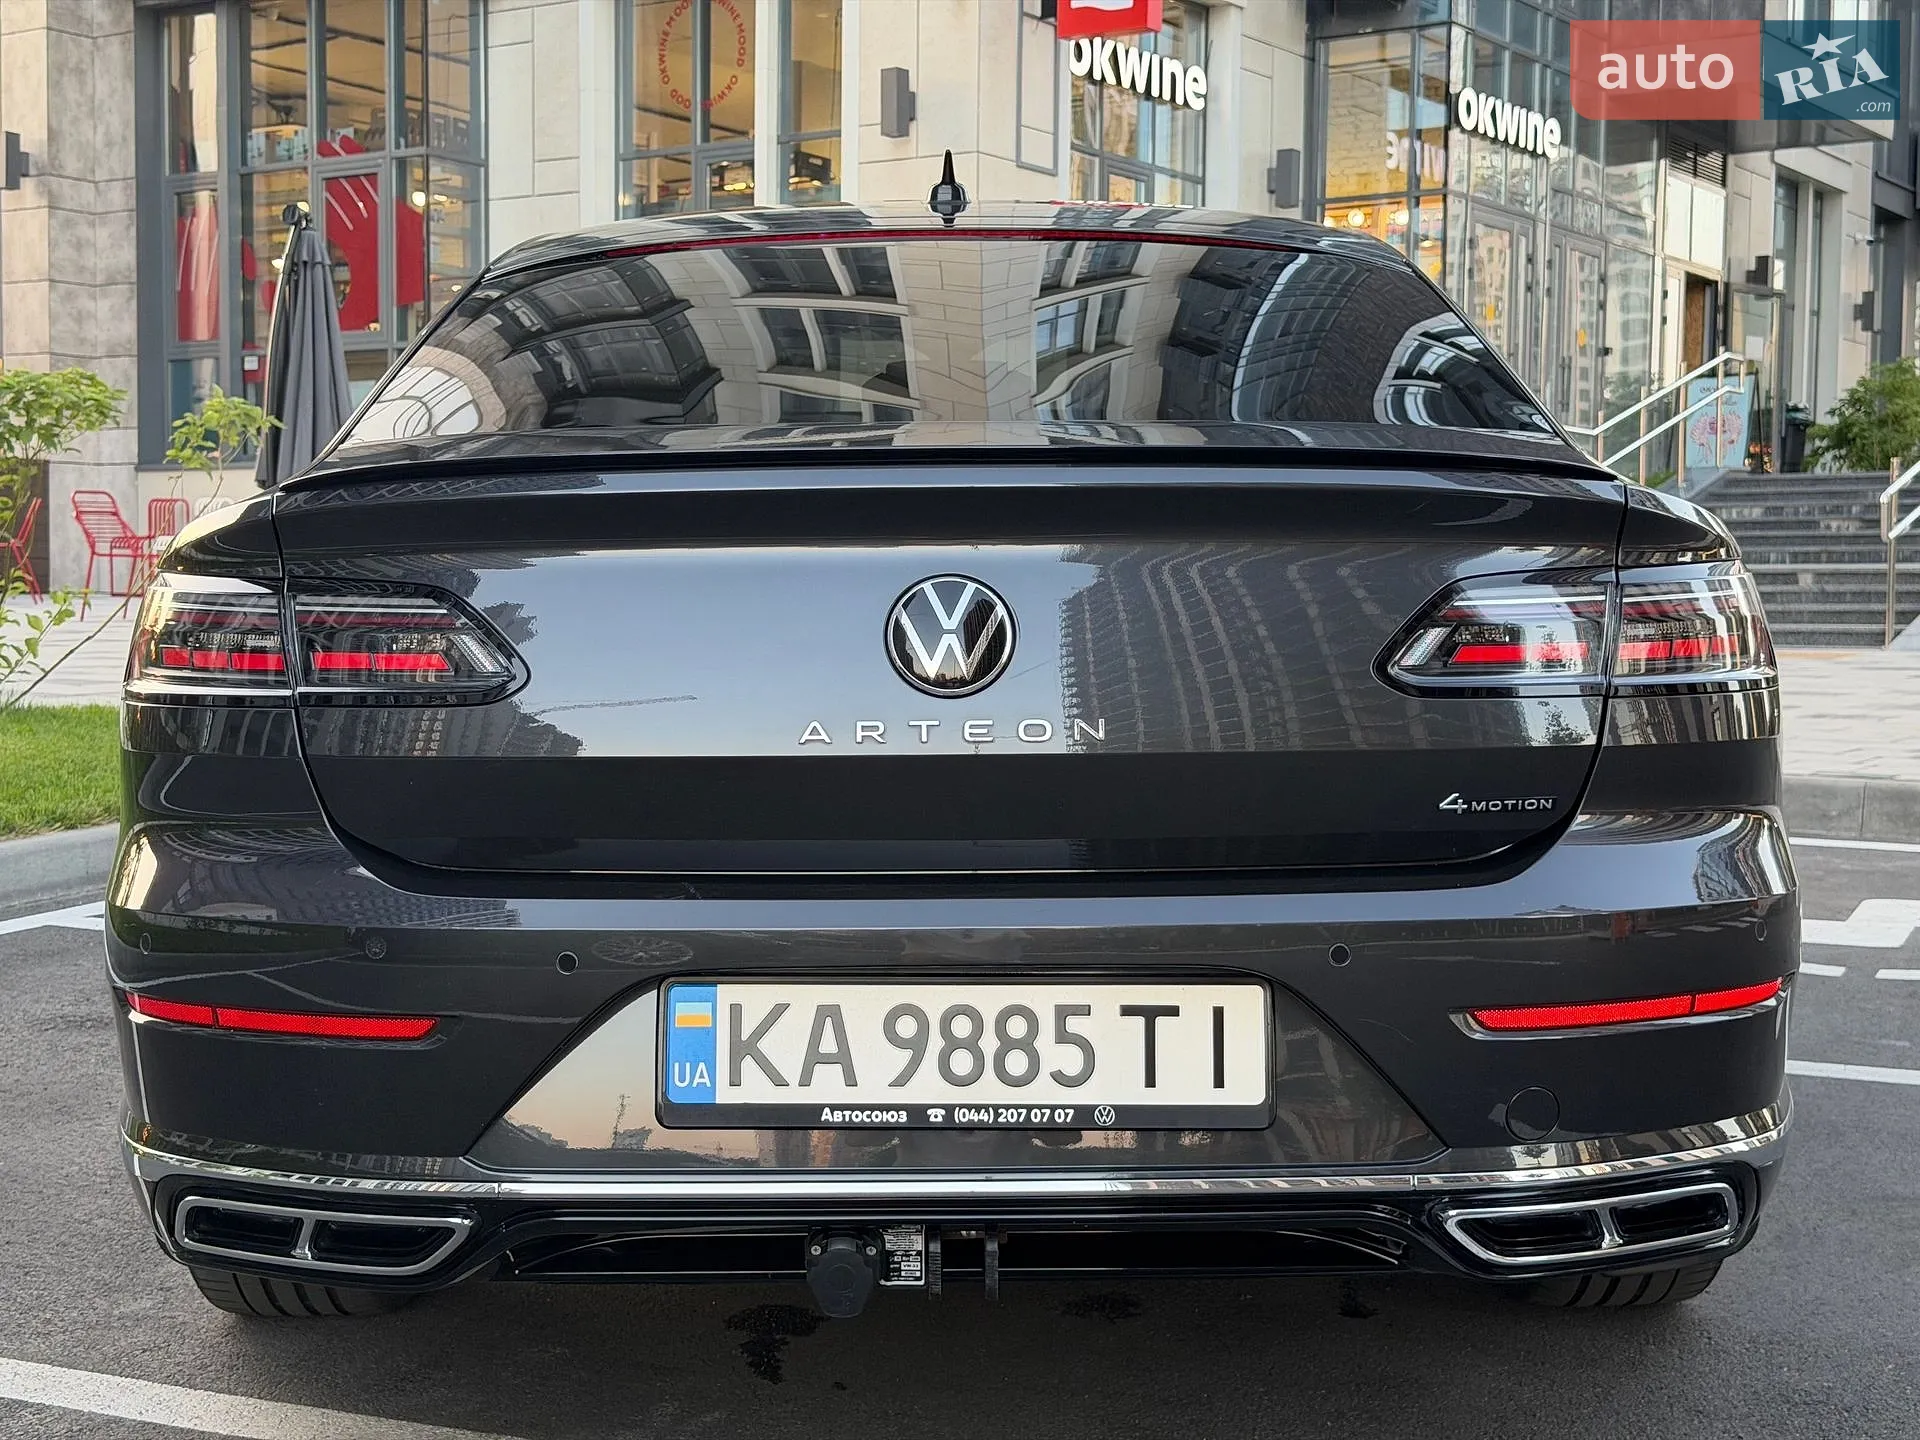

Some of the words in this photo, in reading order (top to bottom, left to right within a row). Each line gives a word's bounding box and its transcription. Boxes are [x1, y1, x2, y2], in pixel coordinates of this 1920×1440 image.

[798, 718, 1105, 744] ARTEON
[1439, 793, 1553, 814] 4MOTION
[728, 1003, 859, 1088] KA
[882, 1003, 1096, 1088] 9885
[1119, 1004, 1225, 1089] TI
[674, 1062, 711, 1088] UA
[953, 1106, 994, 1124] (044)
[998, 1108, 1029, 1123] 207
[1030, 1108, 1050, 1123] 07
[1054, 1108, 1075, 1123] 07
